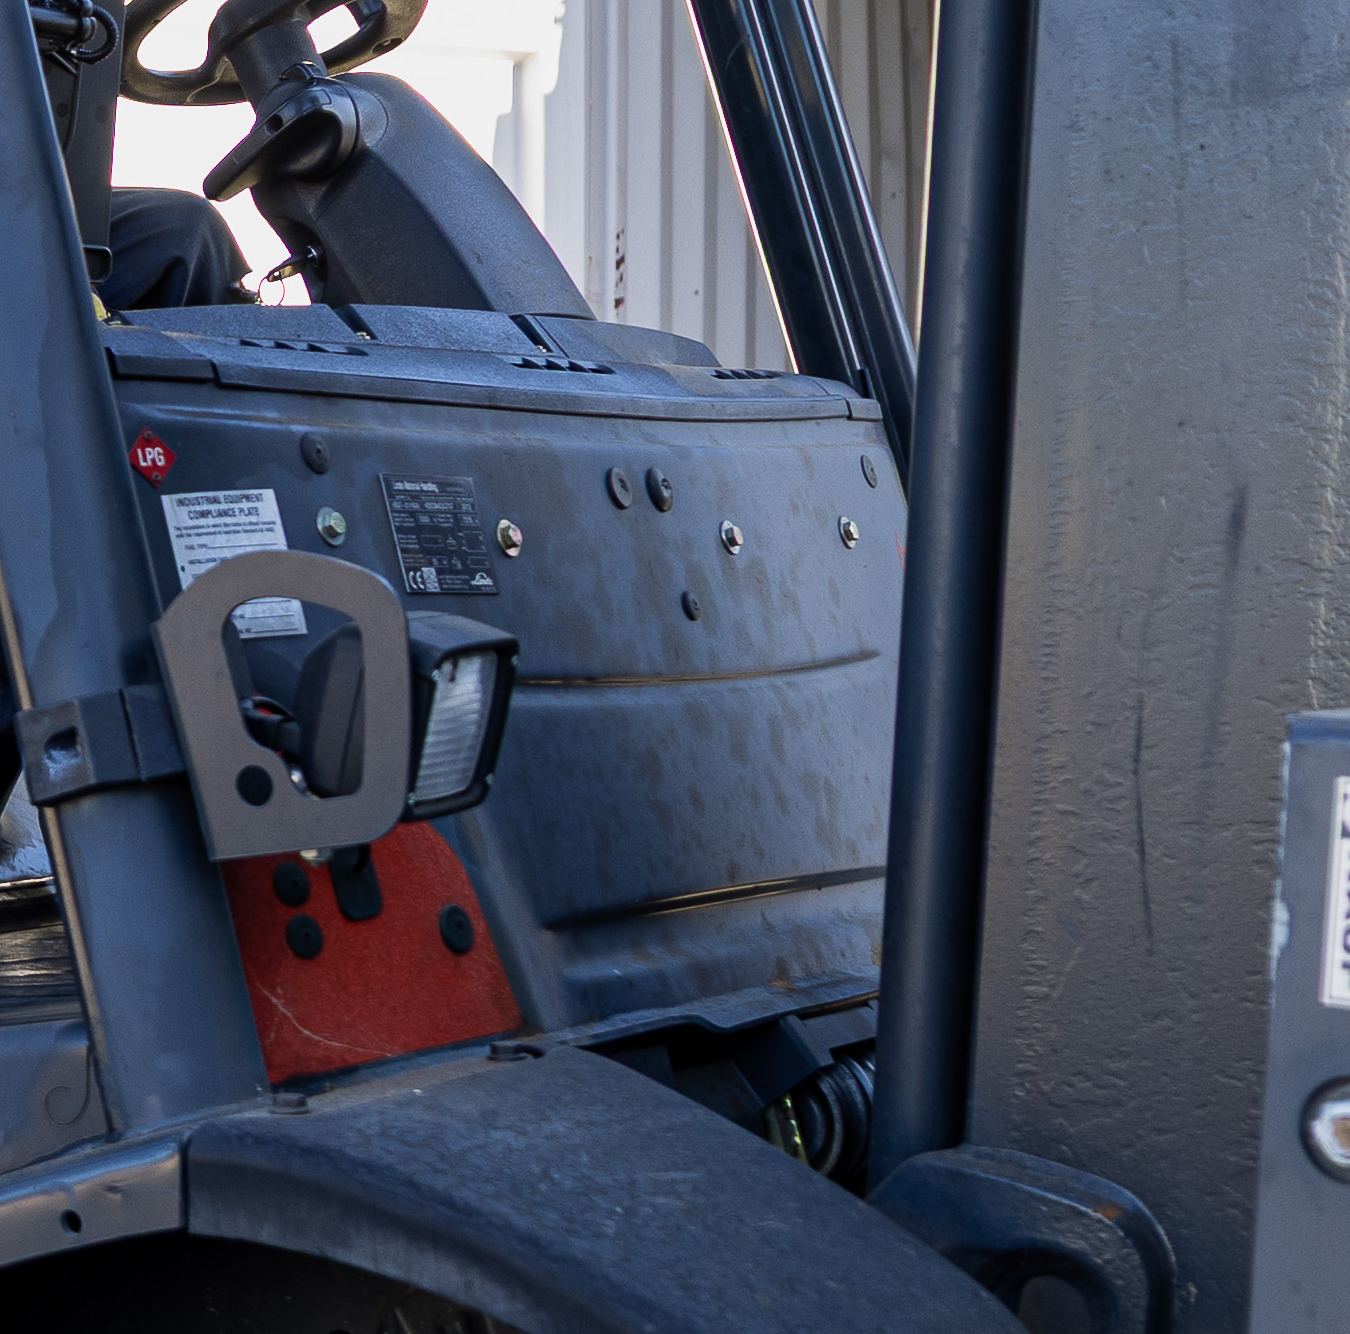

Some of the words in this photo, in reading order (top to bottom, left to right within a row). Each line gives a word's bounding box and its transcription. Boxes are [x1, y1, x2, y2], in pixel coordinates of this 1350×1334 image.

[137, 447, 165, 467] LPG
[175, 496, 222, 507] INDUSTRIAL
[223, 493, 263, 504] EQUIPMENT
[187, 508, 237, 520] COMPLIANCE
[238, 507, 260, 517] PLATE
